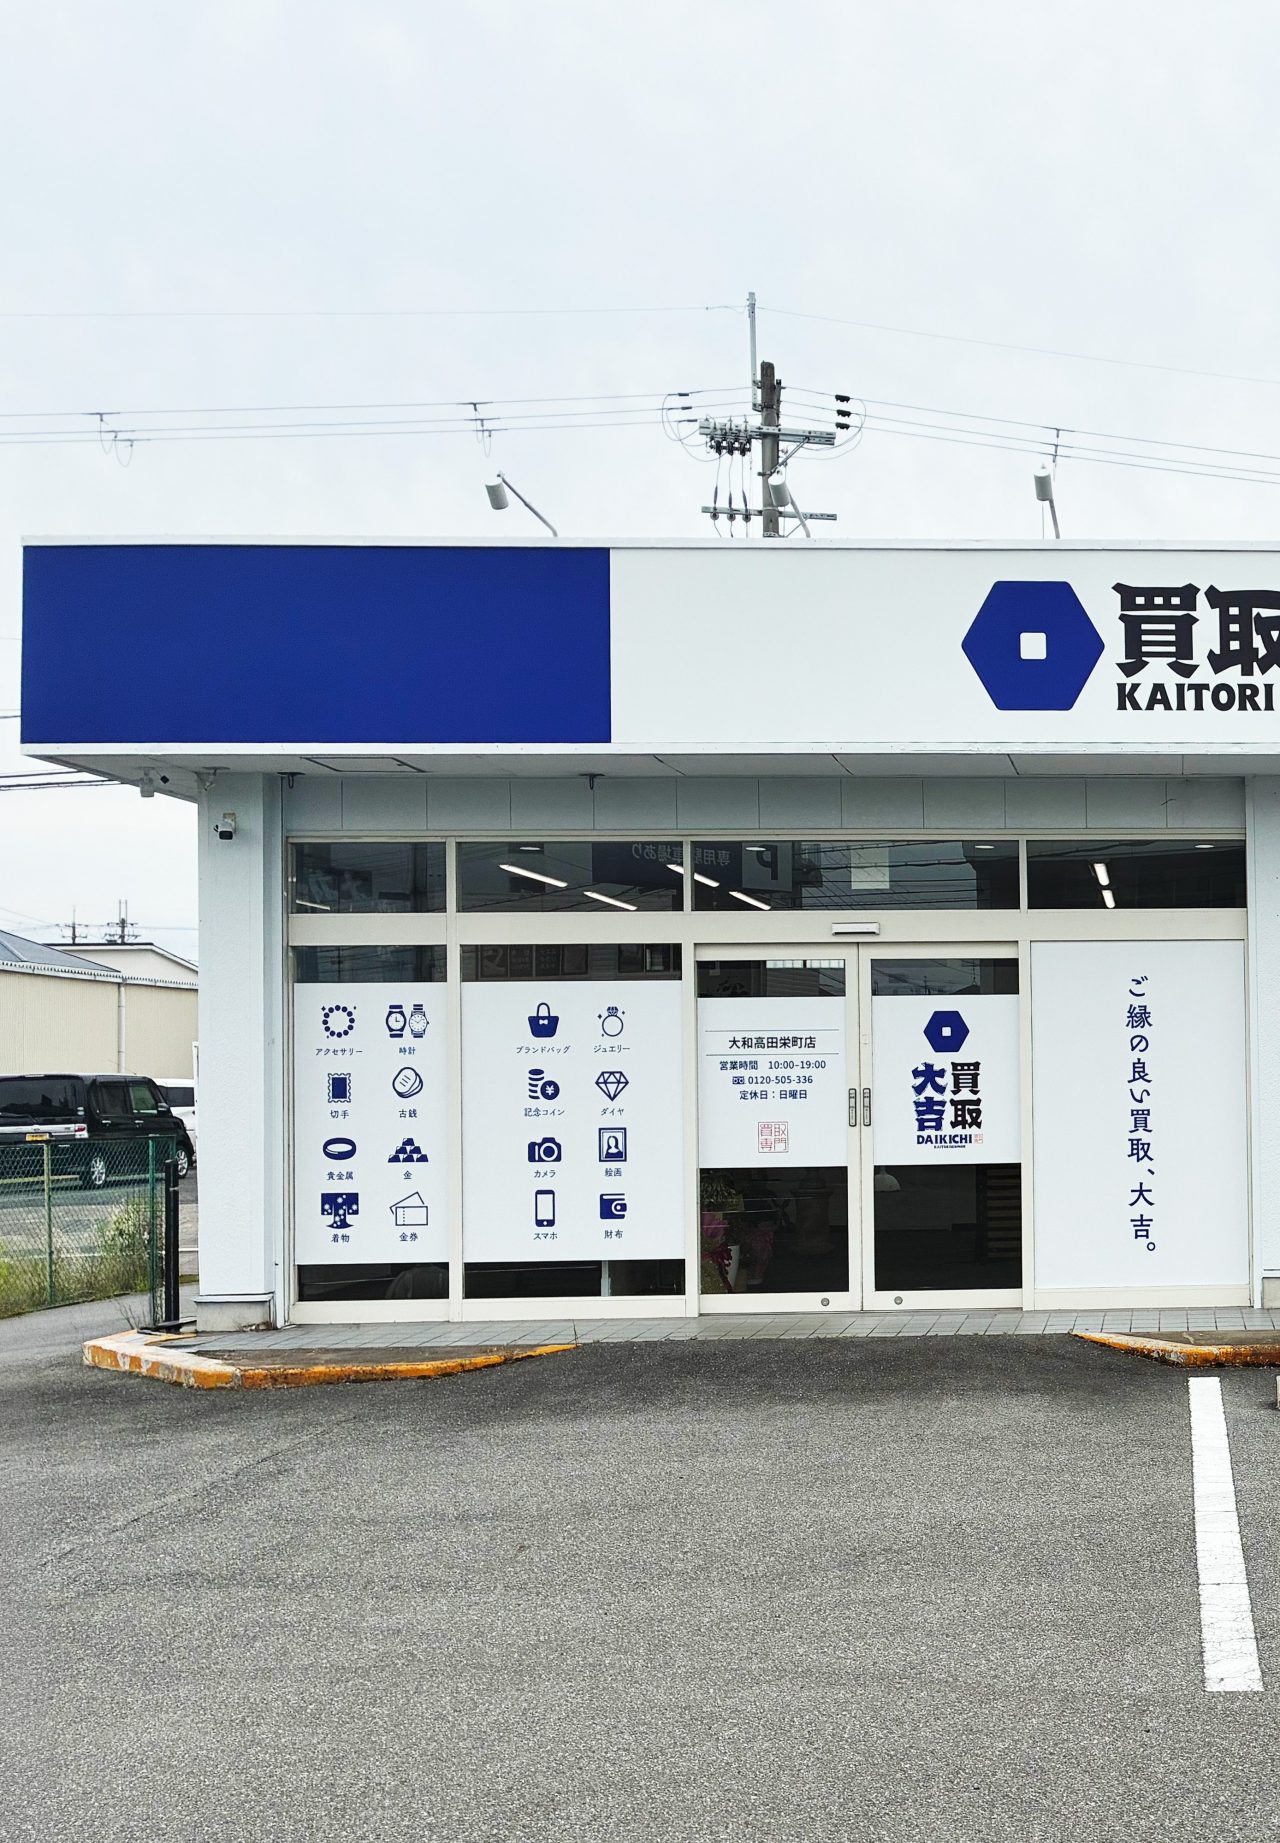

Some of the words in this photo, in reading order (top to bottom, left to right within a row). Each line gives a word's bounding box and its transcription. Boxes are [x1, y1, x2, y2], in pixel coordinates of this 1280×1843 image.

[1116, 683, 1275, 712] KAITORI
[729, 1036, 816, 1049] 大和高田栄町店
[315, 1047, 363, 1056] アクセサリー
[398, 1046, 416, 1056] 時計
[516, 1045, 571, 1054] ブランドバッグ
[593, 1044, 631, 1053] ジュエリー
[719, 1060, 758, 1071] 営業時間
[748, 1075, 814, 1085] 0120-505-336
[912, 1062, 948, 1131] 大吉
[950, 1061, 982, 1129] 買取
[330, 1109, 350, 1119] 切手
[398, 1109, 418, 1119] 古銭
[523, 1107, 565, 1117] 記念コイン
[600, 1107, 625, 1116] ダイヤ
[1126, 975, 1156, 1252] ご縁の良い買取、大吉。
[916, 1133, 973, 1145] DAIKICHI
[327, 1171, 354, 1180] 貴金属
[403, 1170, 412, 1180] 金
[533, 1169, 556, 1178] カメラ
[604, 1167, 622, 1177] 絵画
[330, 1233, 350, 1243] 着物
[399, 1231, 418, 1242] 金券
[533, 1231, 558, 1240] スマホ
[604, 1229, 623, 1239] 財布
